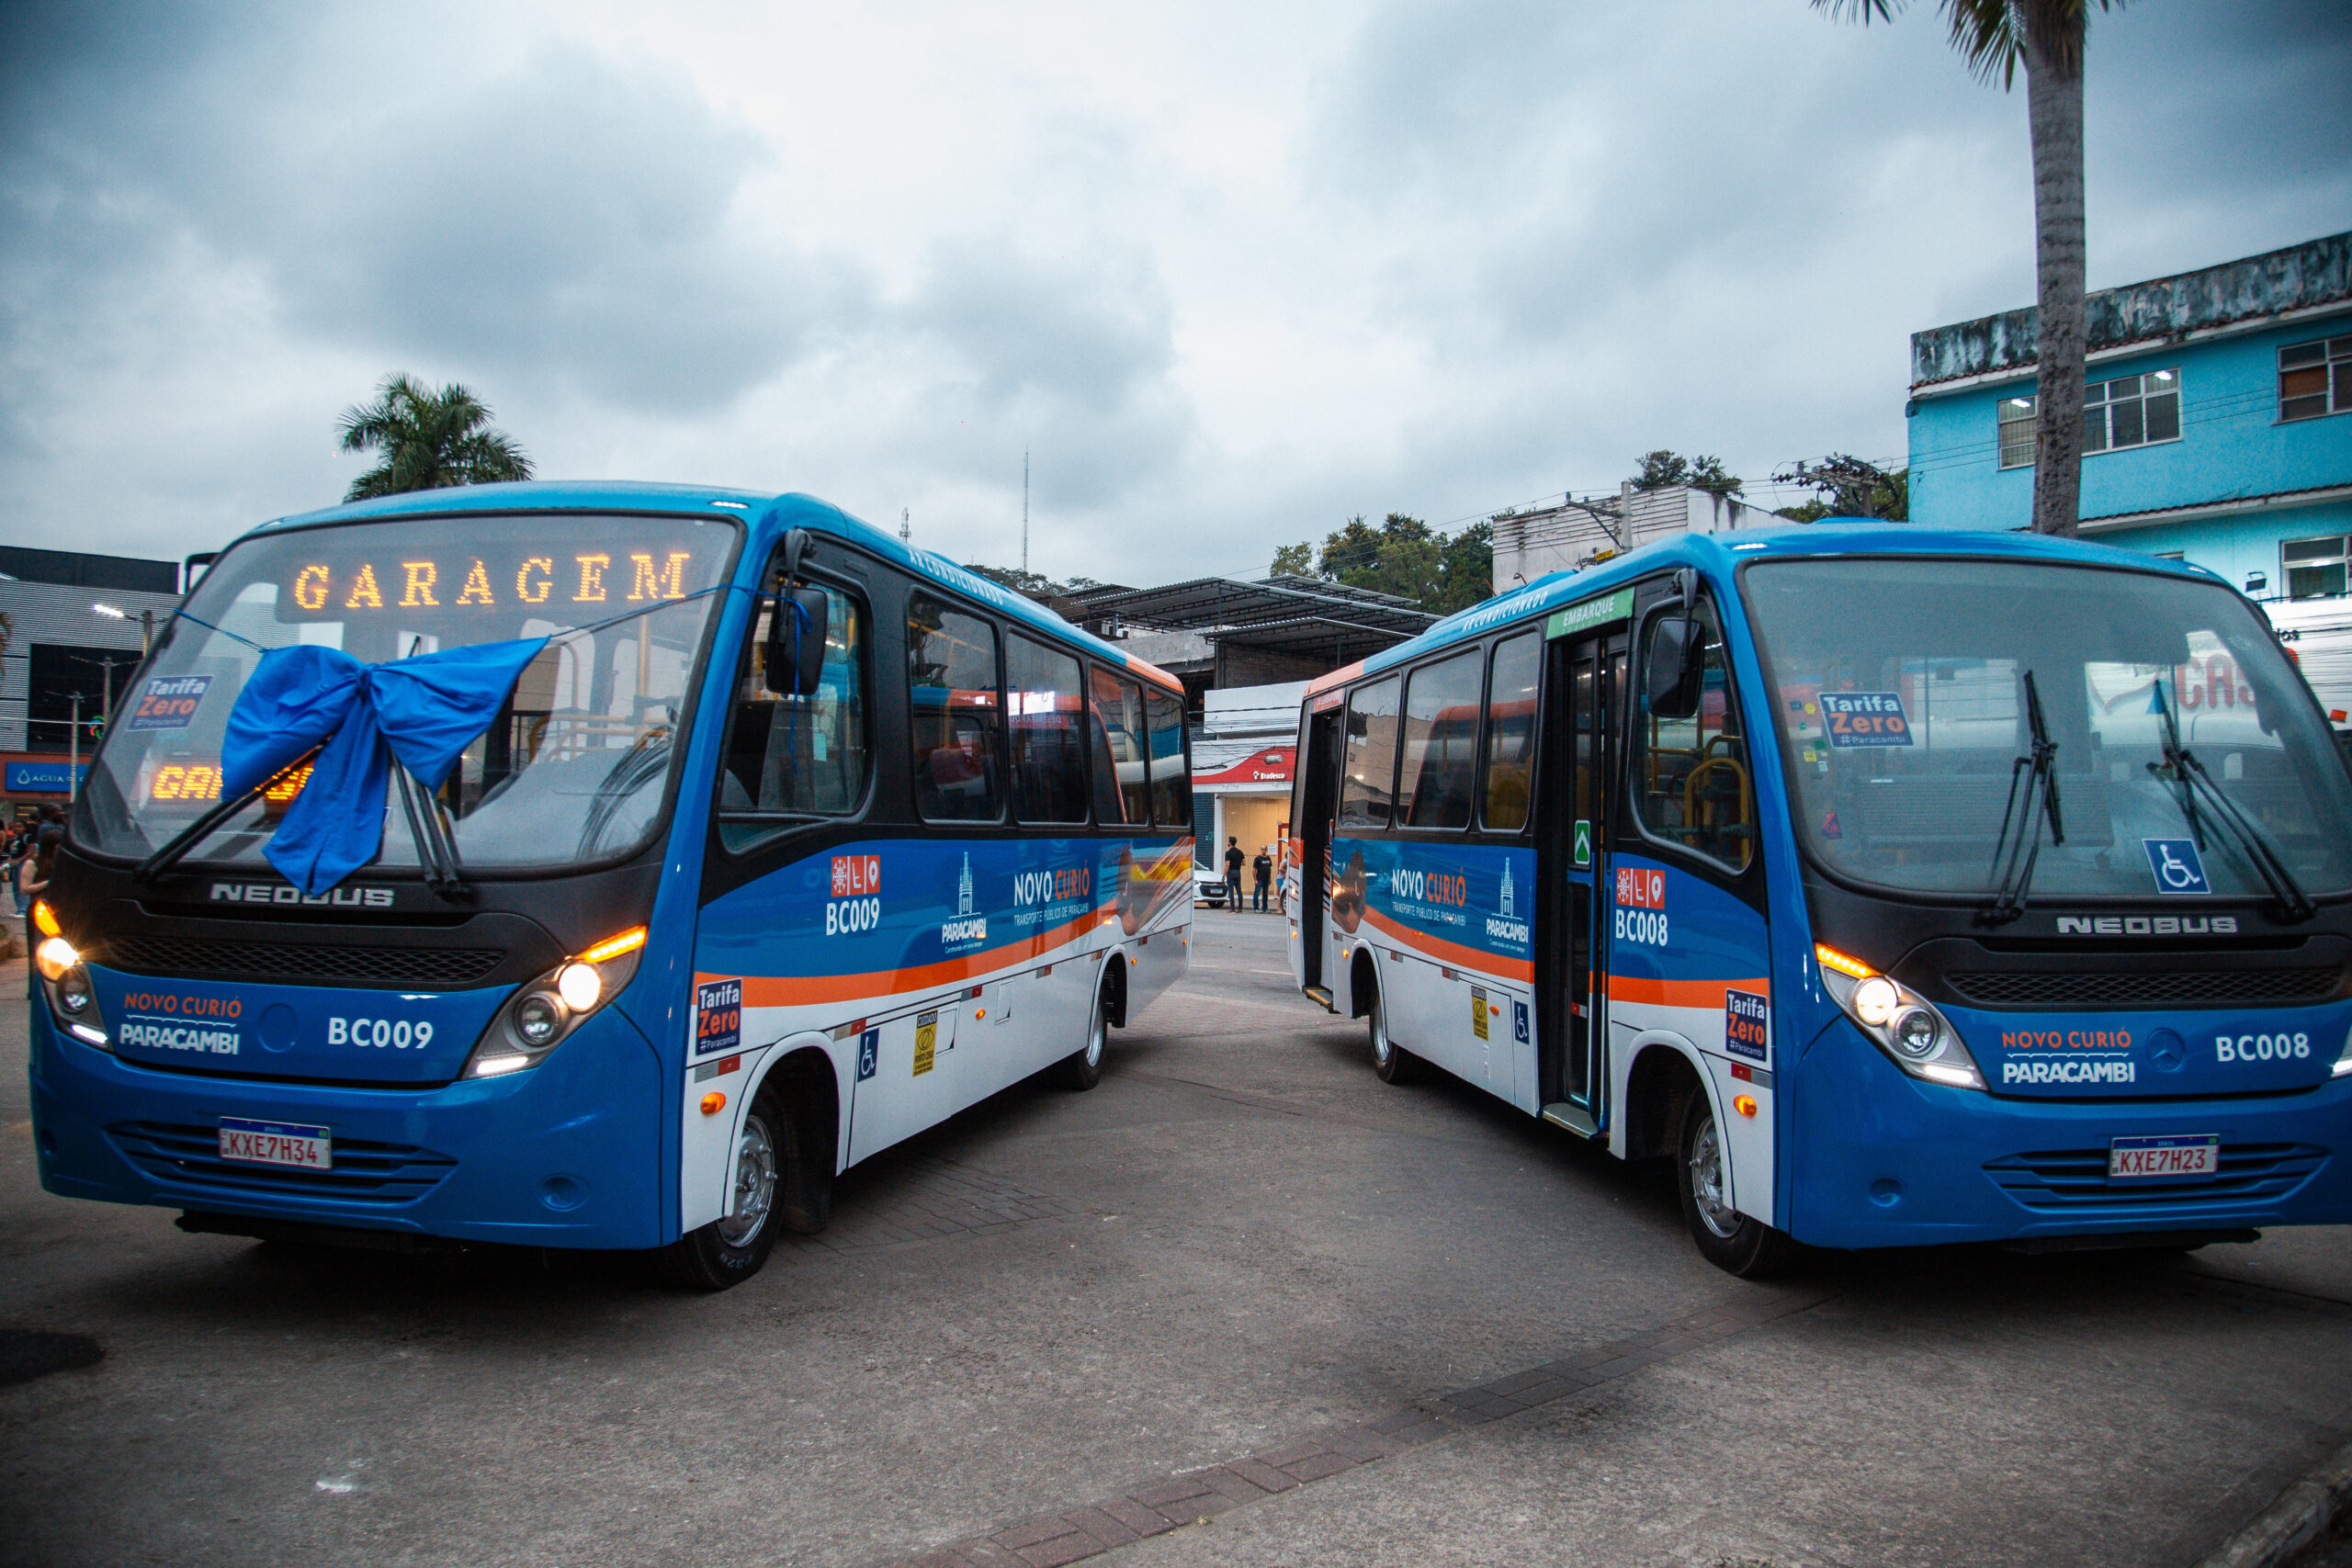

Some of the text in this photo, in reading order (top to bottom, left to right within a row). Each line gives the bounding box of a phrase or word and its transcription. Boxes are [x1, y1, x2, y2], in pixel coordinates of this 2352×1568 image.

[294, 553, 691, 609] GARAGEM
[1472, 591, 1549, 626] CONDICIONADO
[1563, 596, 1615, 626] EMBARQUE
[148, 678, 207, 695] Tarifa
[136, 695, 196, 716] Zero
[1823, 695, 1899, 712] Tarifa
[1829, 712, 1905, 734] Zero
[1839, 735, 1906, 745] #Paracambi
[1260, 772, 1286, 780] Bradesco
[1014, 859, 1090, 907] NOVO CURIÓ
[1392, 866, 1466, 908] NOVO CURIÓ
[826, 897, 880, 936] BC009
[1014, 910, 1044, 928] TRANSPORTE
[1392, 901, 1416, 917] TRANSPORTE
[942, 918, 987, 943] PARACAMBI
[1486, 918, 1529, 943] PARACAMBI
[1615, 908, 1668, 947] BC008
[2057, 917, 2238, 934] NEOBUS
[124, 993, 242, 1018] NOVO CURIÓ
[699, 984, 740, 1010] Tarifa
[1727, 993, 1765, 1020] Tarifa
[327, 1018, 434, 1049] BC009
[698, 1010, 739, 1038] Zero
[1728, 1012, 1765, 1045] Zero
[119, 1024, 241, 1055] PARACAMBI
[700, 1034, 737, 1052] #Paracambi
[1729, 1039, 1763, 1057] #Paracambi
[2002, 1026, 2132, 1049] NOVO CURIÓ
[2215, 1033, 2311, 1062] BC008
[2003, 1062, 2135, 1084] PARACAMBI
[230, 1132, 318, 1163] KXE7H34
[2120, 1148, 2206, 1172] KXE7H23
